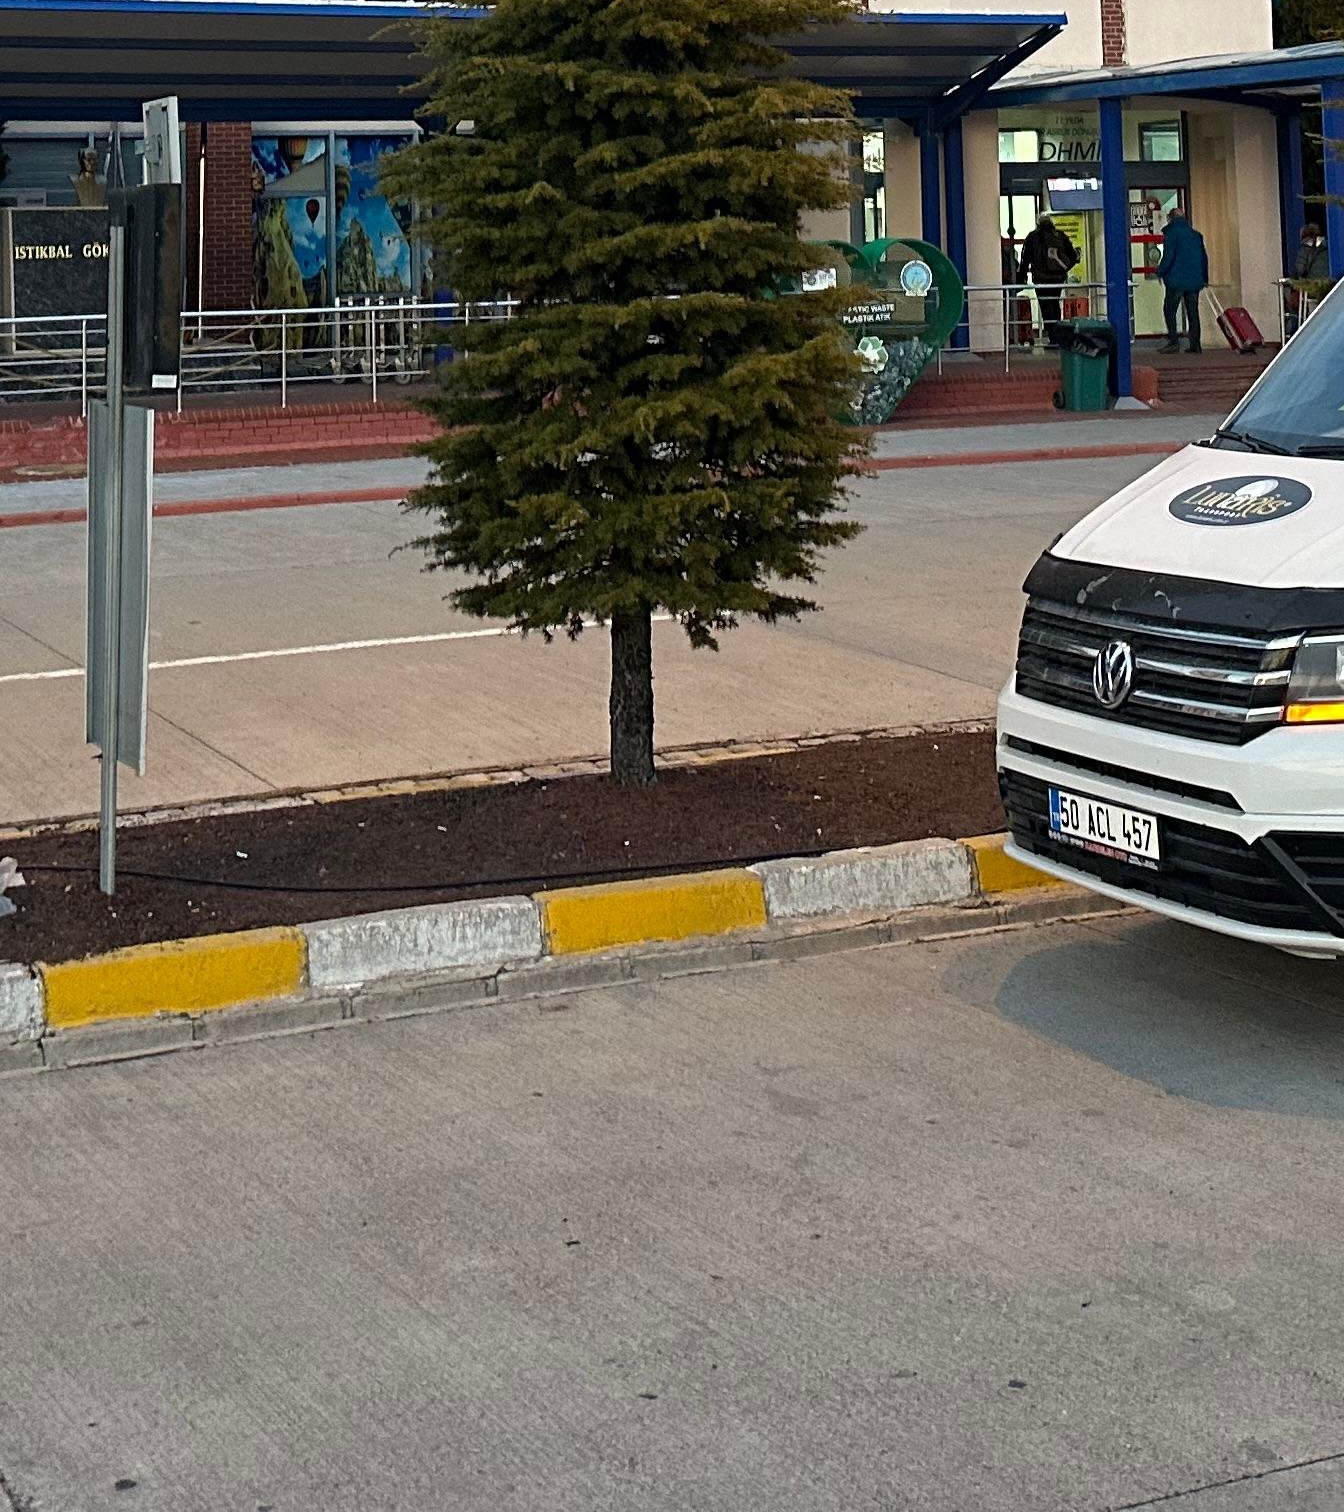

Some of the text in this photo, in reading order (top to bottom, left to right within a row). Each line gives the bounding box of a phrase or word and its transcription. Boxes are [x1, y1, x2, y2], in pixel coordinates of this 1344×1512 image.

[1059, 796, 1080, 831] 50
[1088, 803, 1117, 842] ACL
[1122, 813, 1153, 852] 457
